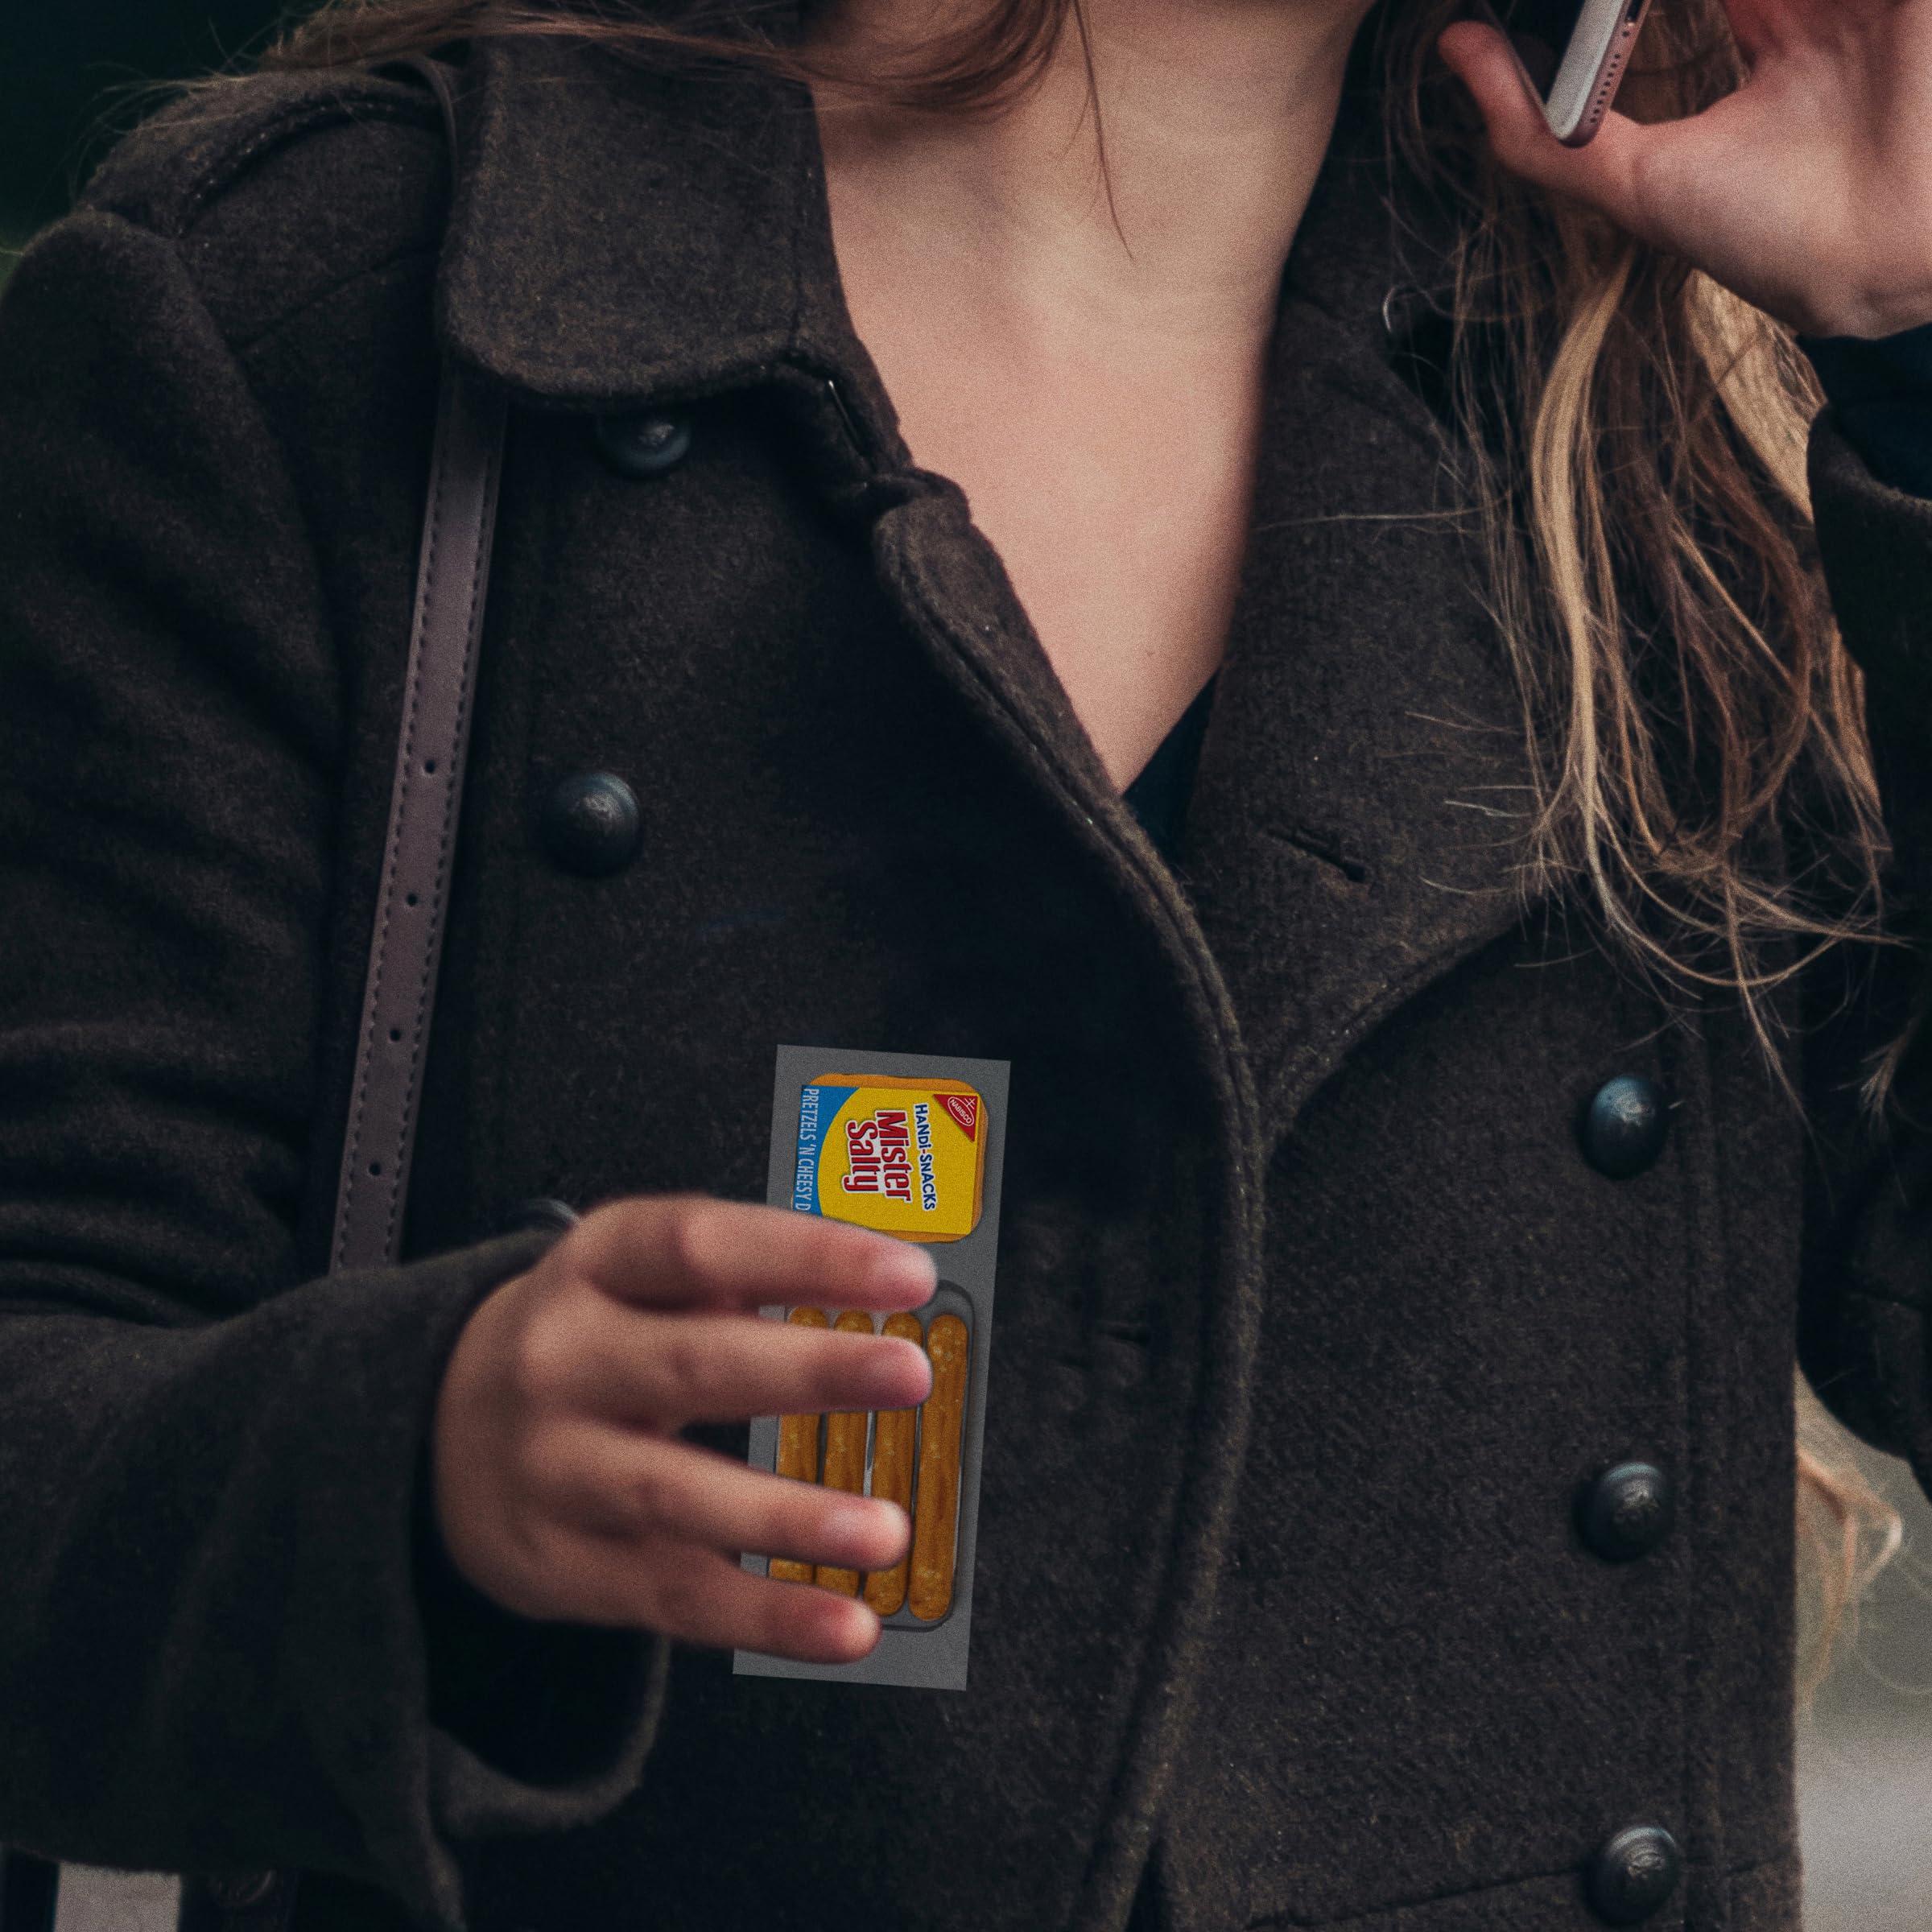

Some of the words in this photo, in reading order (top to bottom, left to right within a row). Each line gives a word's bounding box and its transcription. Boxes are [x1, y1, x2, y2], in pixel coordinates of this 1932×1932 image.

[799, 1088, 819, 1141] PRETZELS
[950, 1099, 972, 1124] NABISCO
[795, 1158, 815, 1200] CHEESY
[843, 1120, 882, 1193] Salty
[875, 1110, 912, 1203] Mister
[795, 1203, 811, 1211] D
